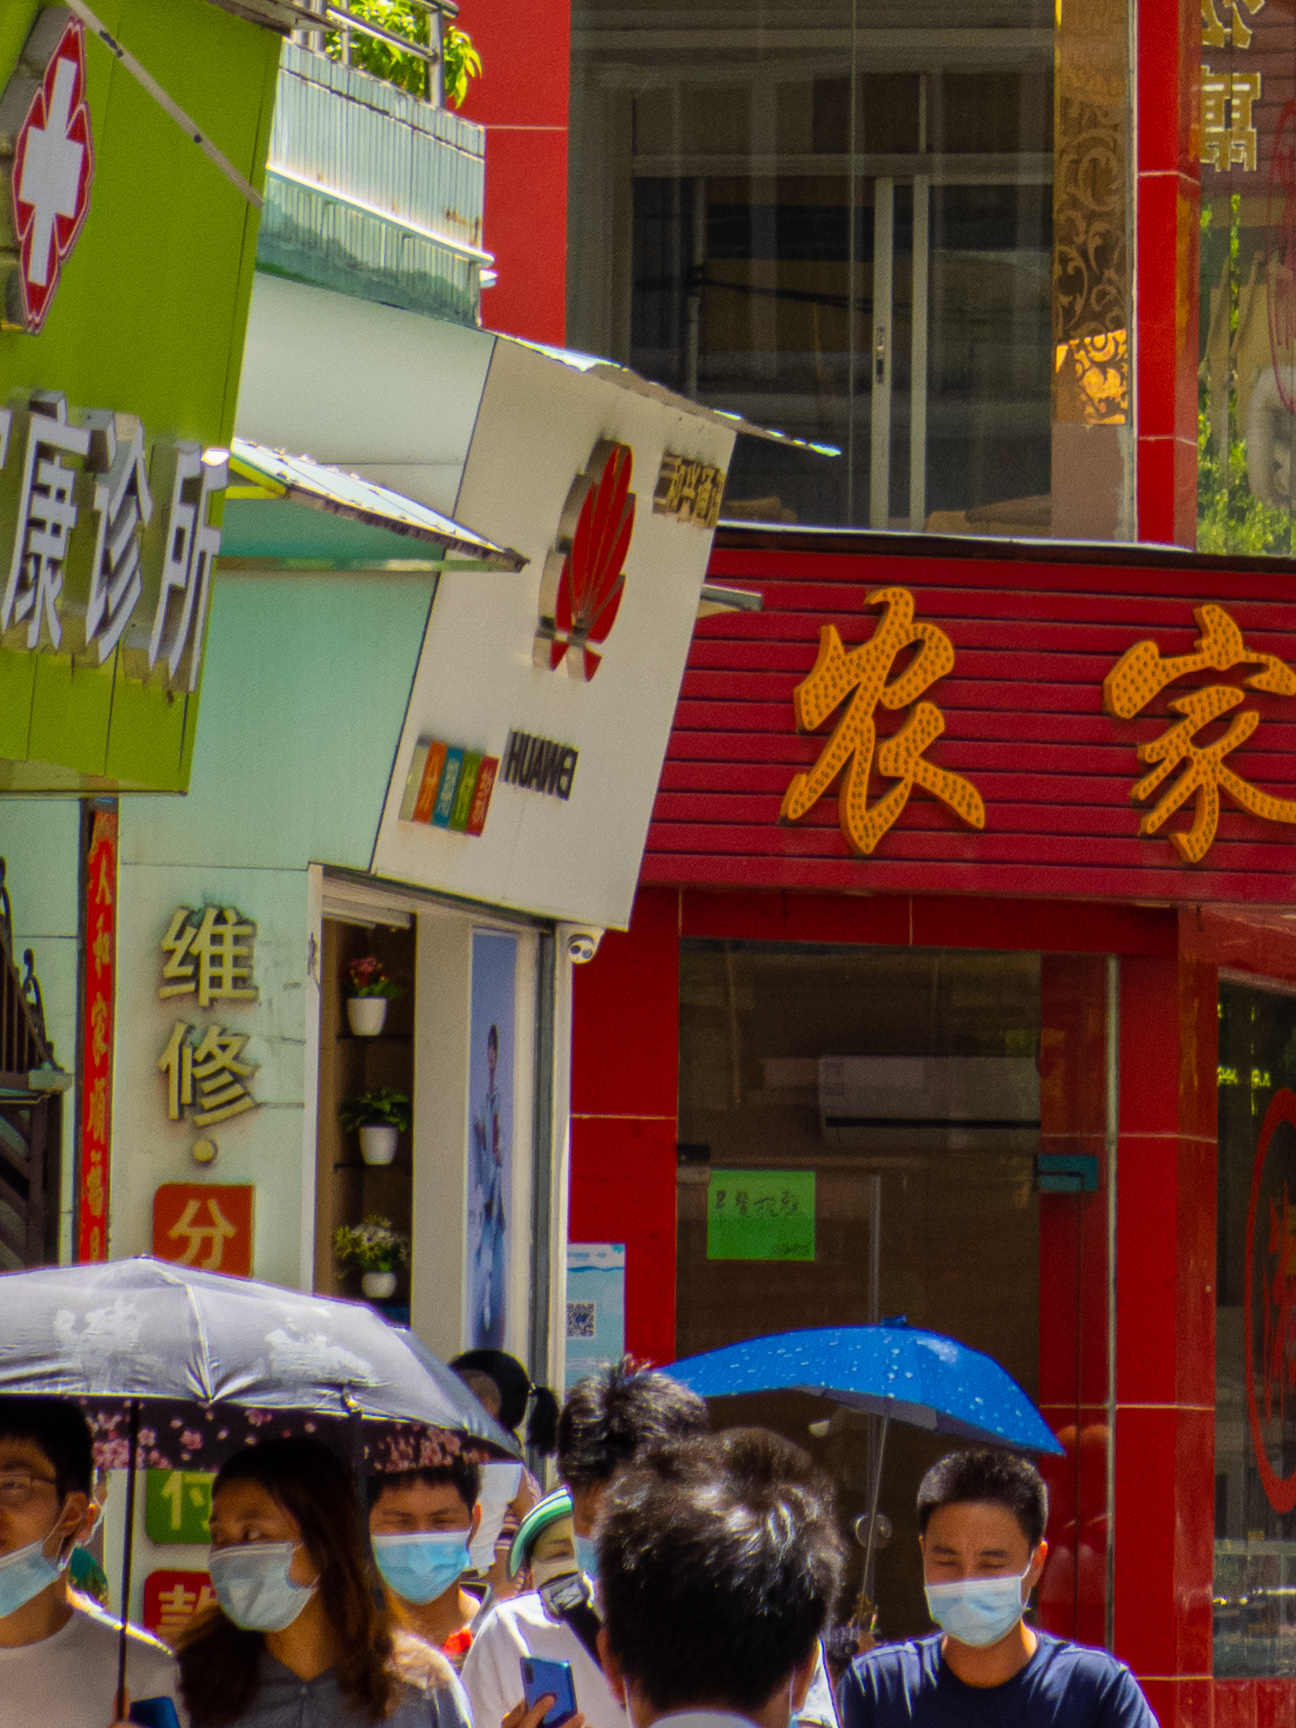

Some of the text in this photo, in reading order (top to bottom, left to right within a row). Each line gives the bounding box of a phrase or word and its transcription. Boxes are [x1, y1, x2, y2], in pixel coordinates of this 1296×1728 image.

[0, 399, 230, 692] 康诊所
[502, 728, 580, 802] HUAWEI
[158, 902, 259, 1130] 维修
[167, 1199, 238, 1269] 分
